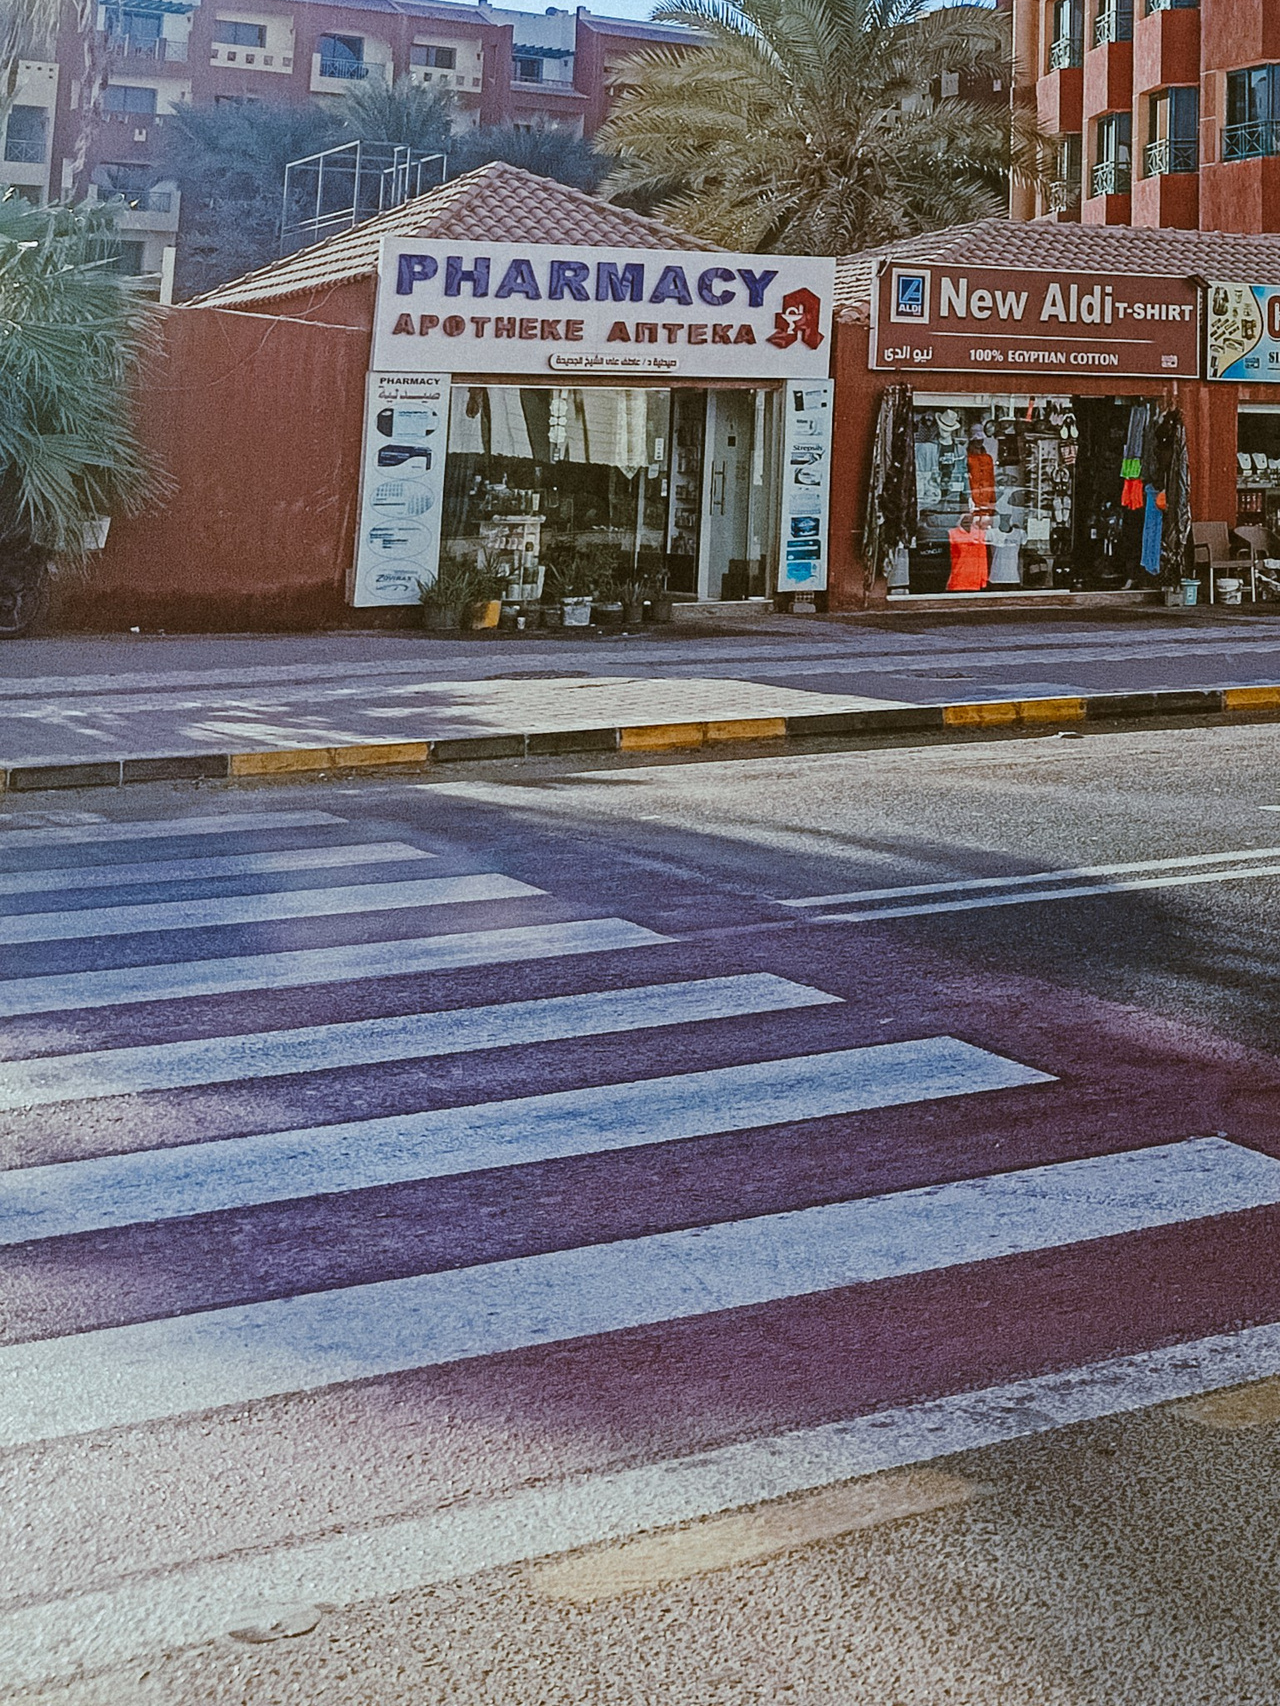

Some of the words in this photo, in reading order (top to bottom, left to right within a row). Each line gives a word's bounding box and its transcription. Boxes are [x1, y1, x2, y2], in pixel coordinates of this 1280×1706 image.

[396, 253, 779, 307] PHARMACY
[898, 303, 922, 314] ALDI
[940, 277, 1028, 320] New
[1040, 282, 1113, 324] Aldi
[1115, 302, 1194, 321] T-SHIRT
[392, 312, 584, 341] APOTHEKE
[606, 321, 757, 345] АПТЕКА
[914, 346, 933, 363] نيو
[969, 349, 1004, 362] 100%
[1007, 350, 1066, 364] EGYPTIAN
[1069, 352, 1119, 366] COTTON
[379, 377, 441, 386] PHARMACY
